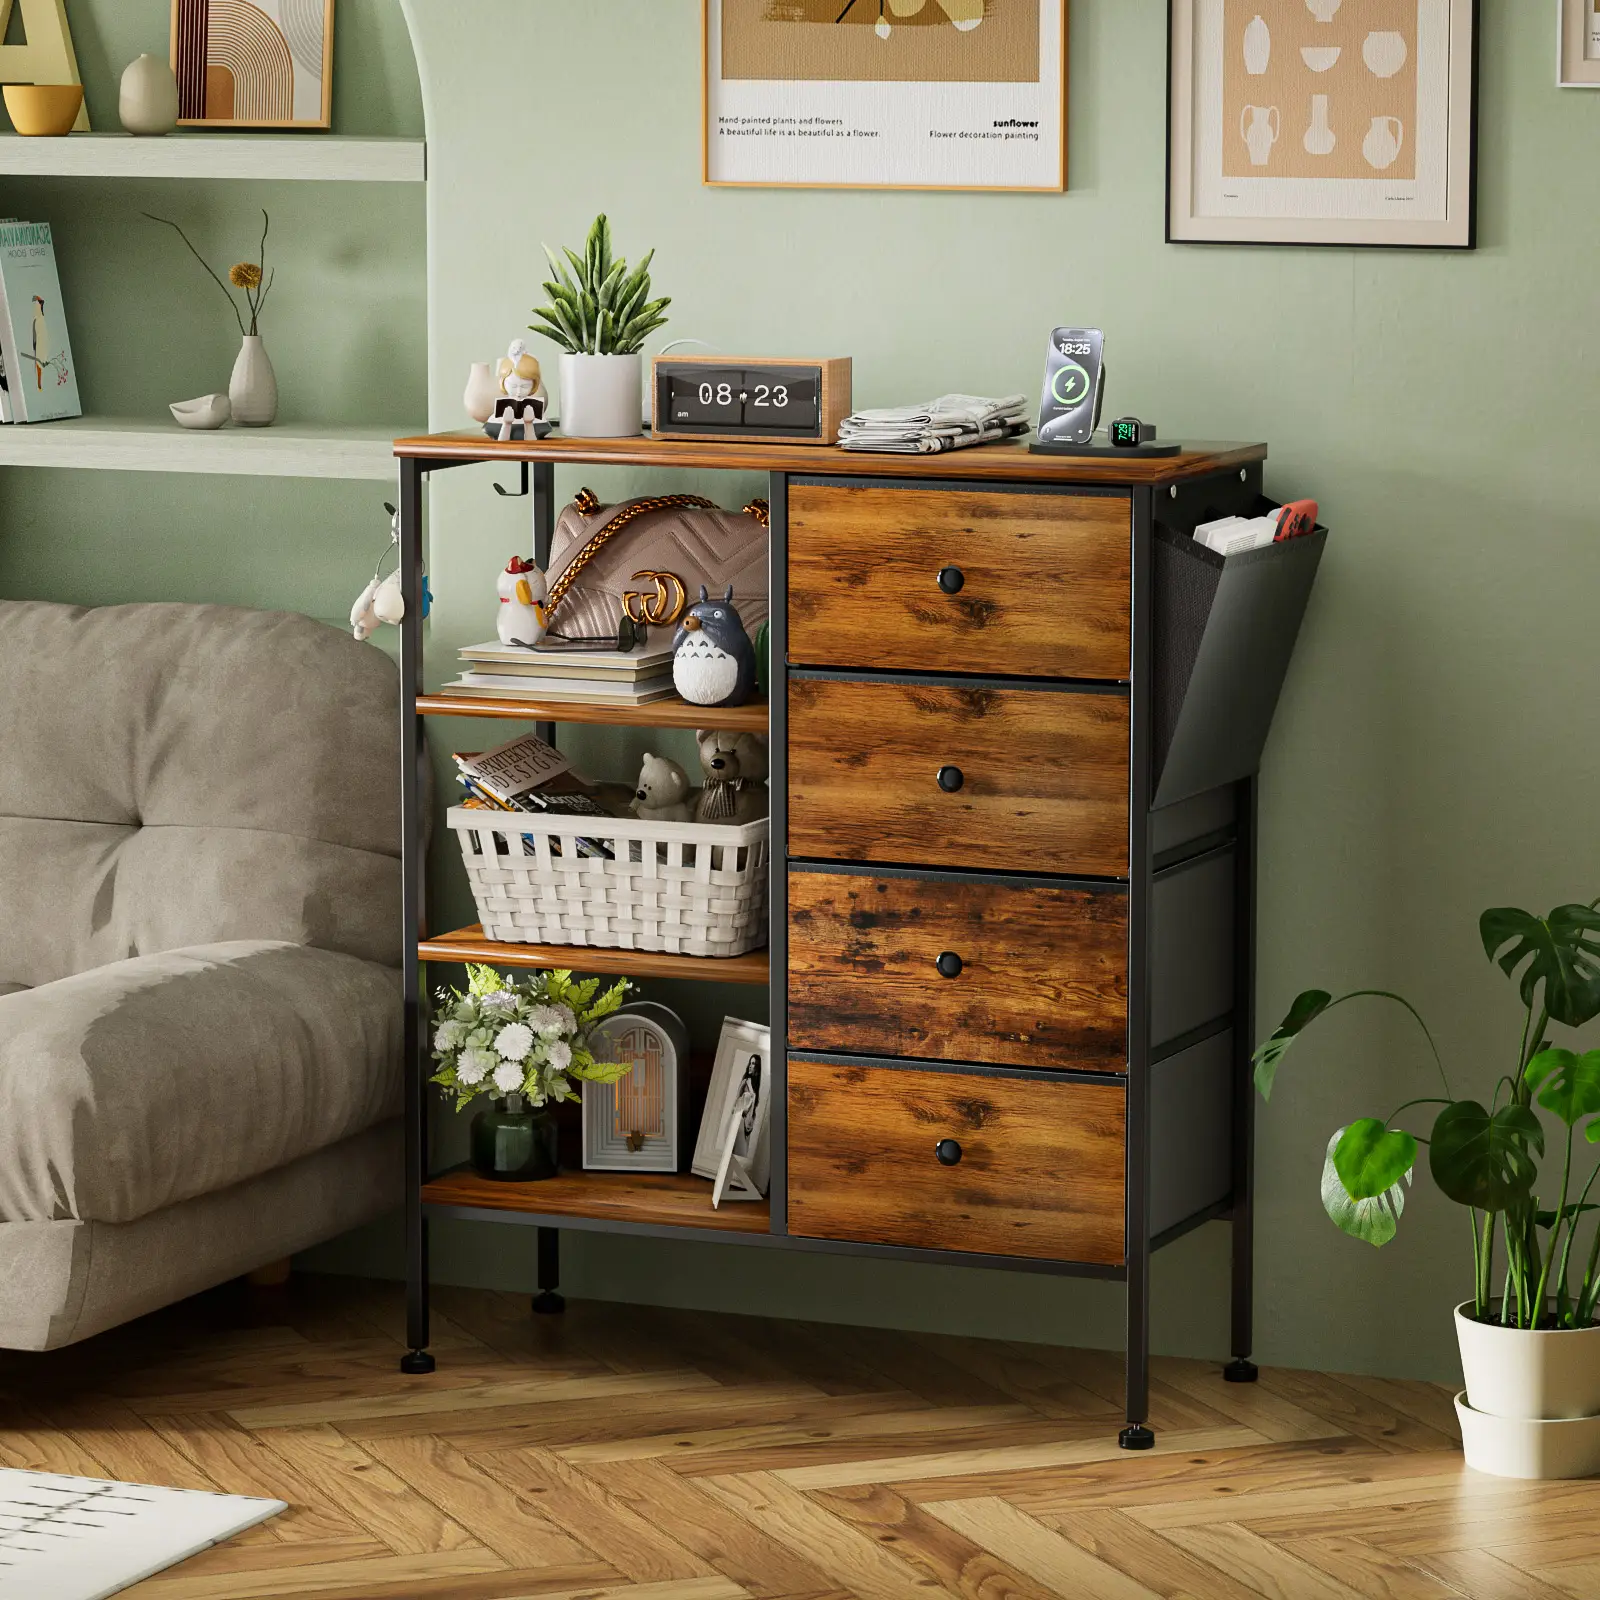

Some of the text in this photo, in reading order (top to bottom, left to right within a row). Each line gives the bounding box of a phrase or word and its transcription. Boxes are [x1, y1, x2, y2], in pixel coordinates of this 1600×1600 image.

[772, 117, 796, 126] plants
[798, 117, 813, 125] and
[815, 117, 843, 126] flowers
[993, 119, 1039, 128] sunflower
[726, 128, 763, 136] beautiful
[764, 128, 777, 136] life
[778, 128, 785, 136] is
[798, 128, 834, 137] beautiful
[929, 130, 1039, 141] Flower decoration painting
[1059, 342, 1091, 355] 18:25
[698, 382, 789, 408] 08 23
[677, 410, 689, 418] am
[490, 748, 566, 788] DESIGN
[540, 792, 591, 804] domus
